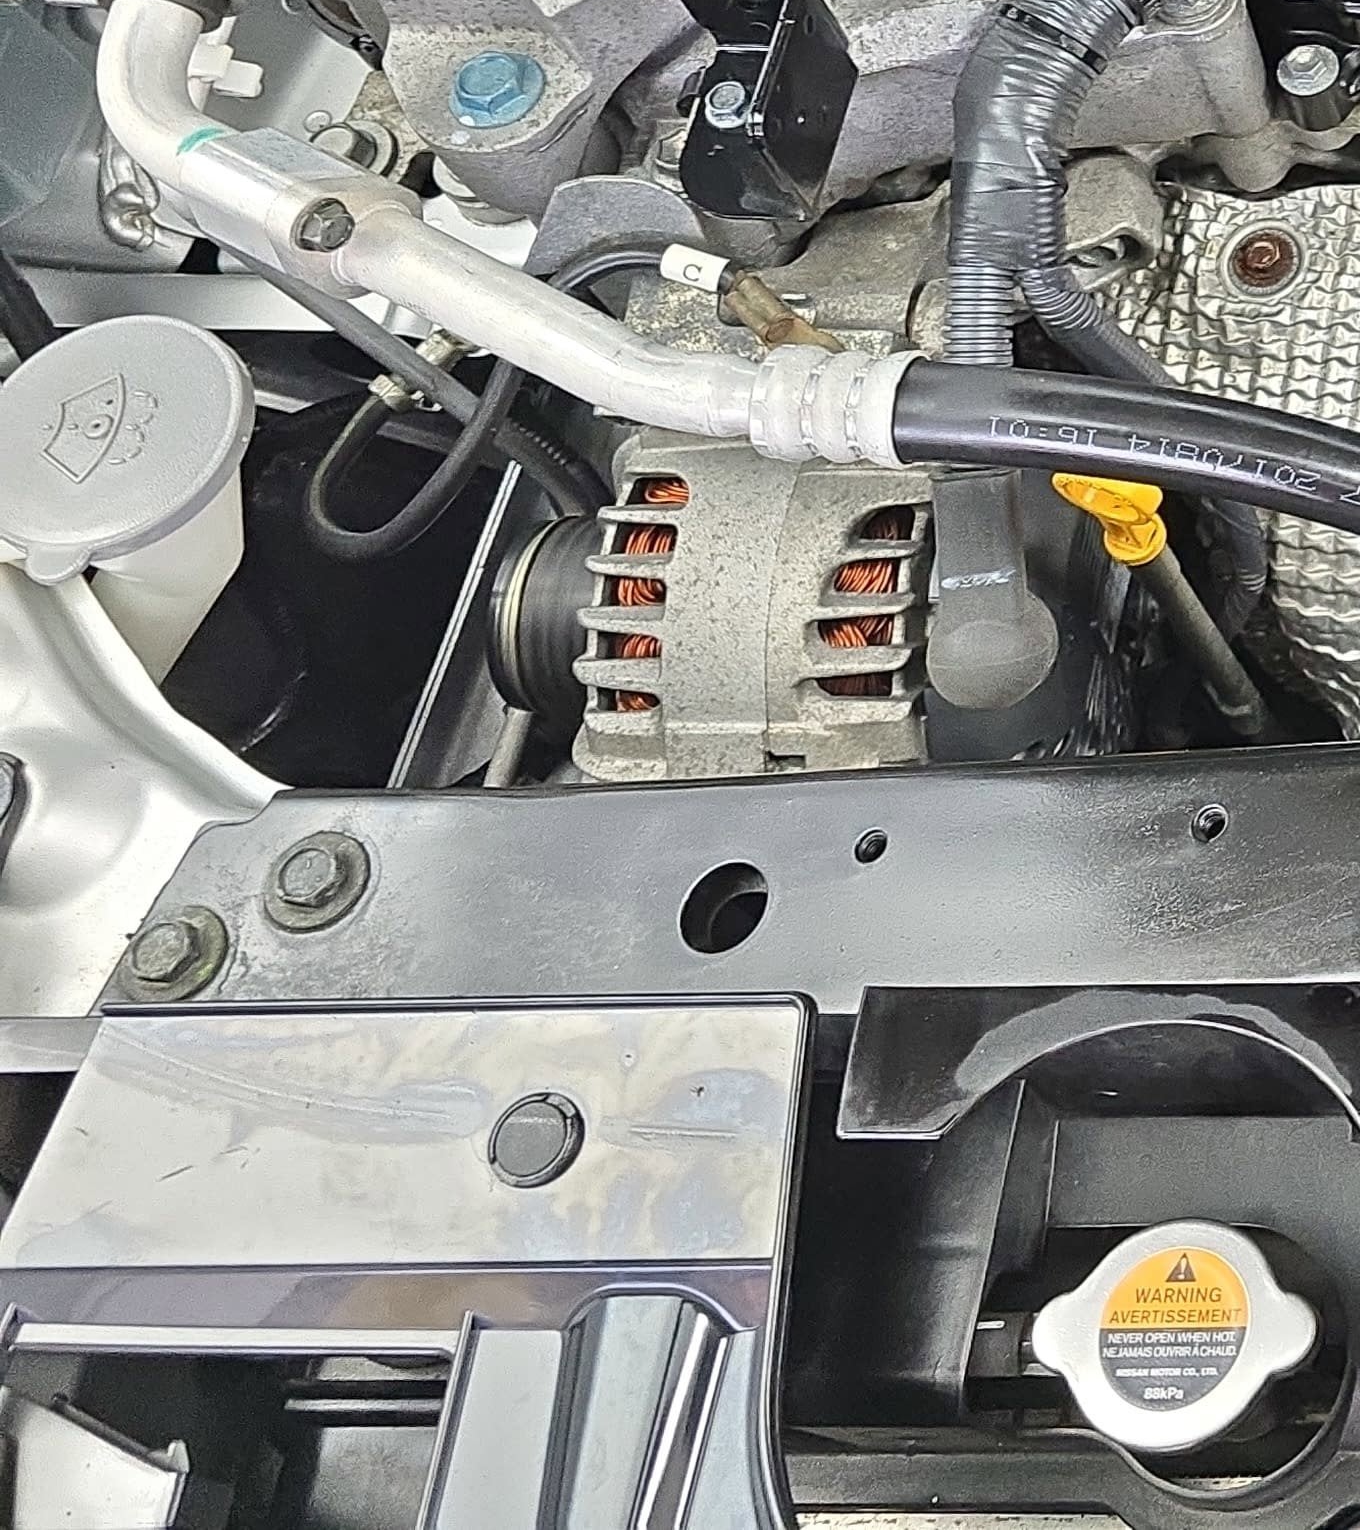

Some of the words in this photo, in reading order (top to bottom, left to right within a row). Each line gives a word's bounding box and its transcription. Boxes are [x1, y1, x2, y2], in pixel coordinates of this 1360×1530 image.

[988, 415, 1100, 450] 16:01
[1127, 432, 1322, 492] 20170814
[1135, 1286, 1222, 1304] WARNING
[1109, 1308, 1242, 1325] AVERTISSEMENT
[1107, 1332, 1144, 1345] NEVER
[1145, 1332, 1176, 1344] OPEN
[1177, 1332, 1211, 1344] WHEN
[1212, 1331, 1236, 1343] HOT.
[1103, 1347, 1118, 1359] NE
[1118, 1346, 1152, 1359] JAMAIS
[1153, 1346, 1191, 1358] OUVRIR
[1200, 1346, 1237, 1358] CHAUD.
